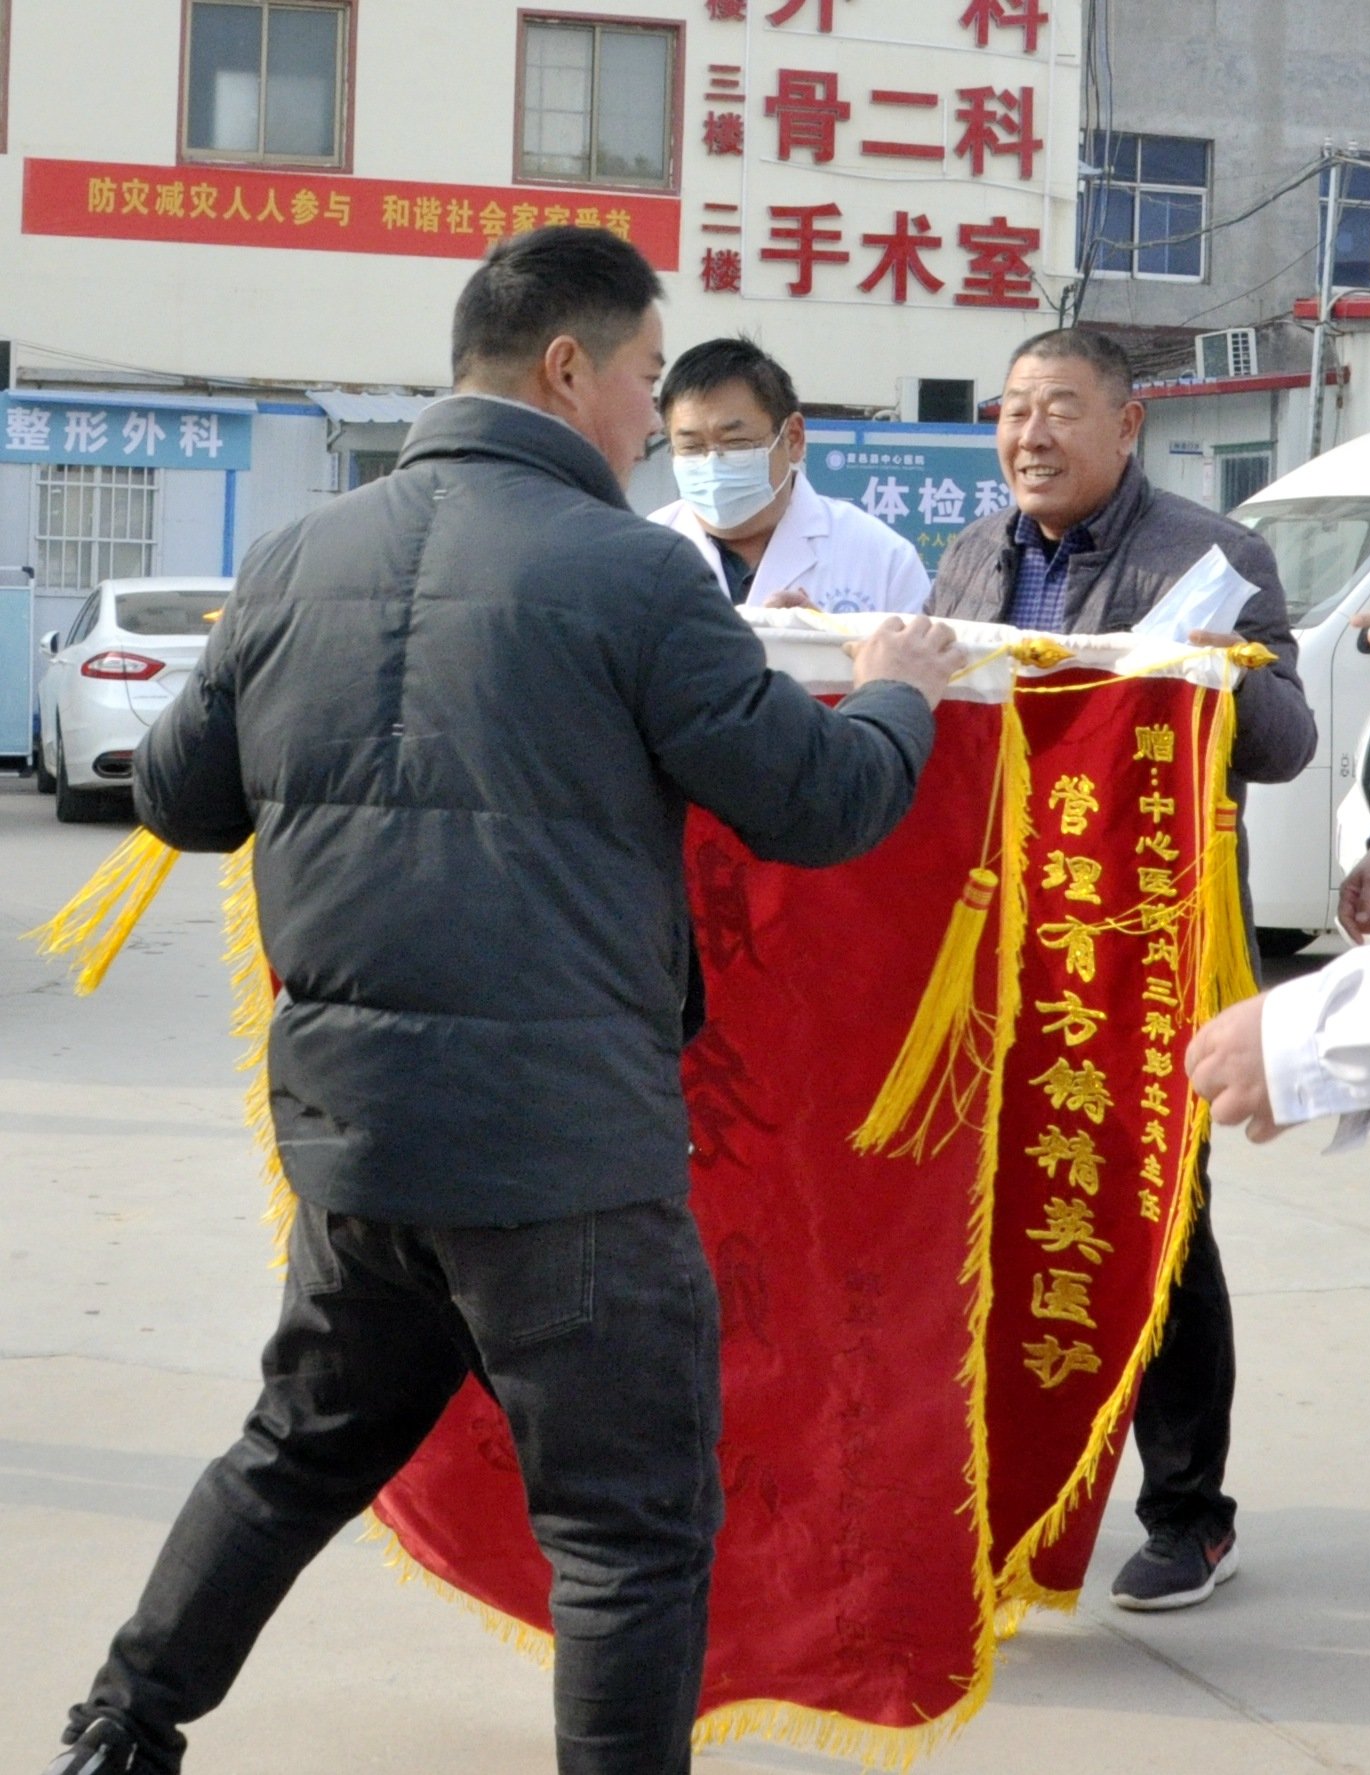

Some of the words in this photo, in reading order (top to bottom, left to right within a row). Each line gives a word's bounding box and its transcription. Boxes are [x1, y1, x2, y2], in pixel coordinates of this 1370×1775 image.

[703, 63, 746, 156] 三楼
[764, 67, 1044, 180] 骨二科
[87, 177, 352, 226] 防灾减灾人人参与
[700, 202, 743, 294] 二楼
[760, 202, 1042, 309] 手术室
[5, 406, 224, 459] 整形外科
[861, 475, 1017, 525] 体检科
